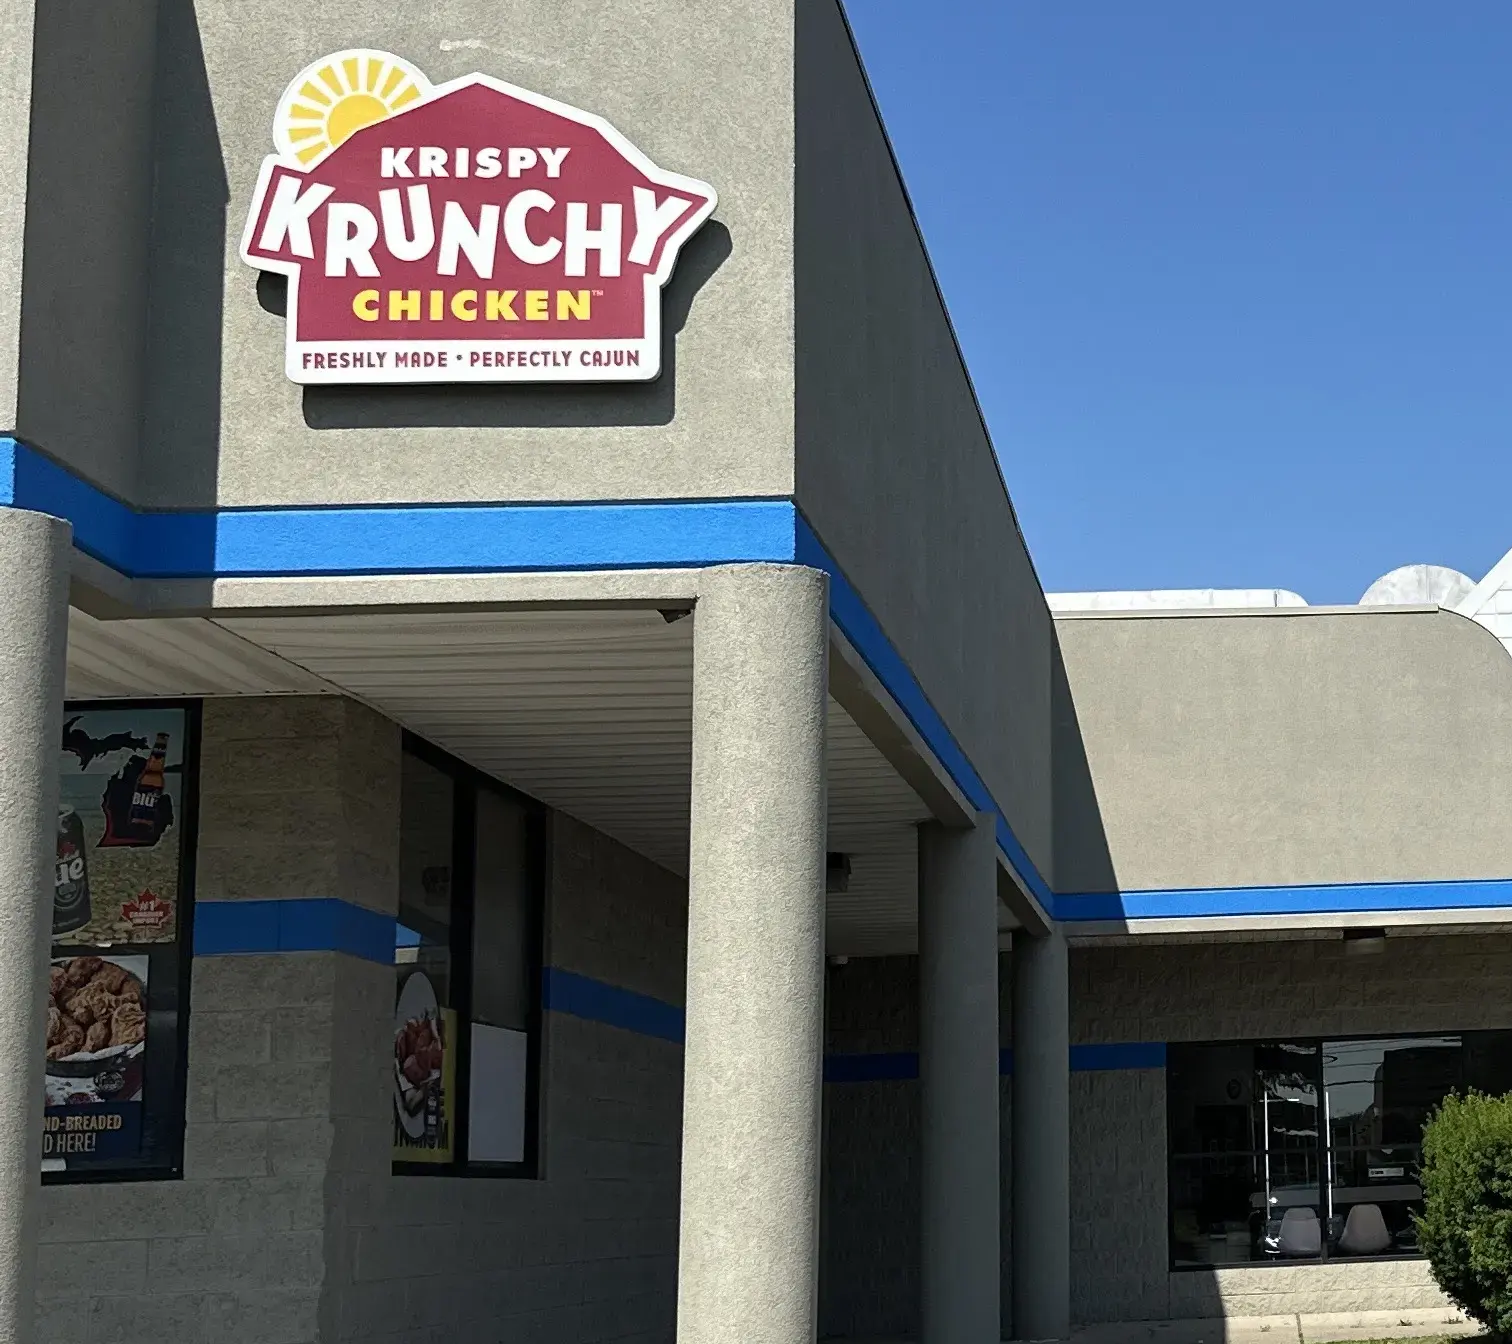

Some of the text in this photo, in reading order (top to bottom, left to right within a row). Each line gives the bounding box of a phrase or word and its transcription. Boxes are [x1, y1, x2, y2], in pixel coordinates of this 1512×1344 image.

[380, 146, 572, 179] KRISPY
[257, 173, 693, 279] KRUNCHY
[351, 289, 591, 323] CHICKEN
[302, 349, 640, 370] FRESHLY MADE PERFECTLY CAJUN
[43, 1114, 122, 1131] ND-BREADED
[56, 1132, 96, 1152] HERE!
